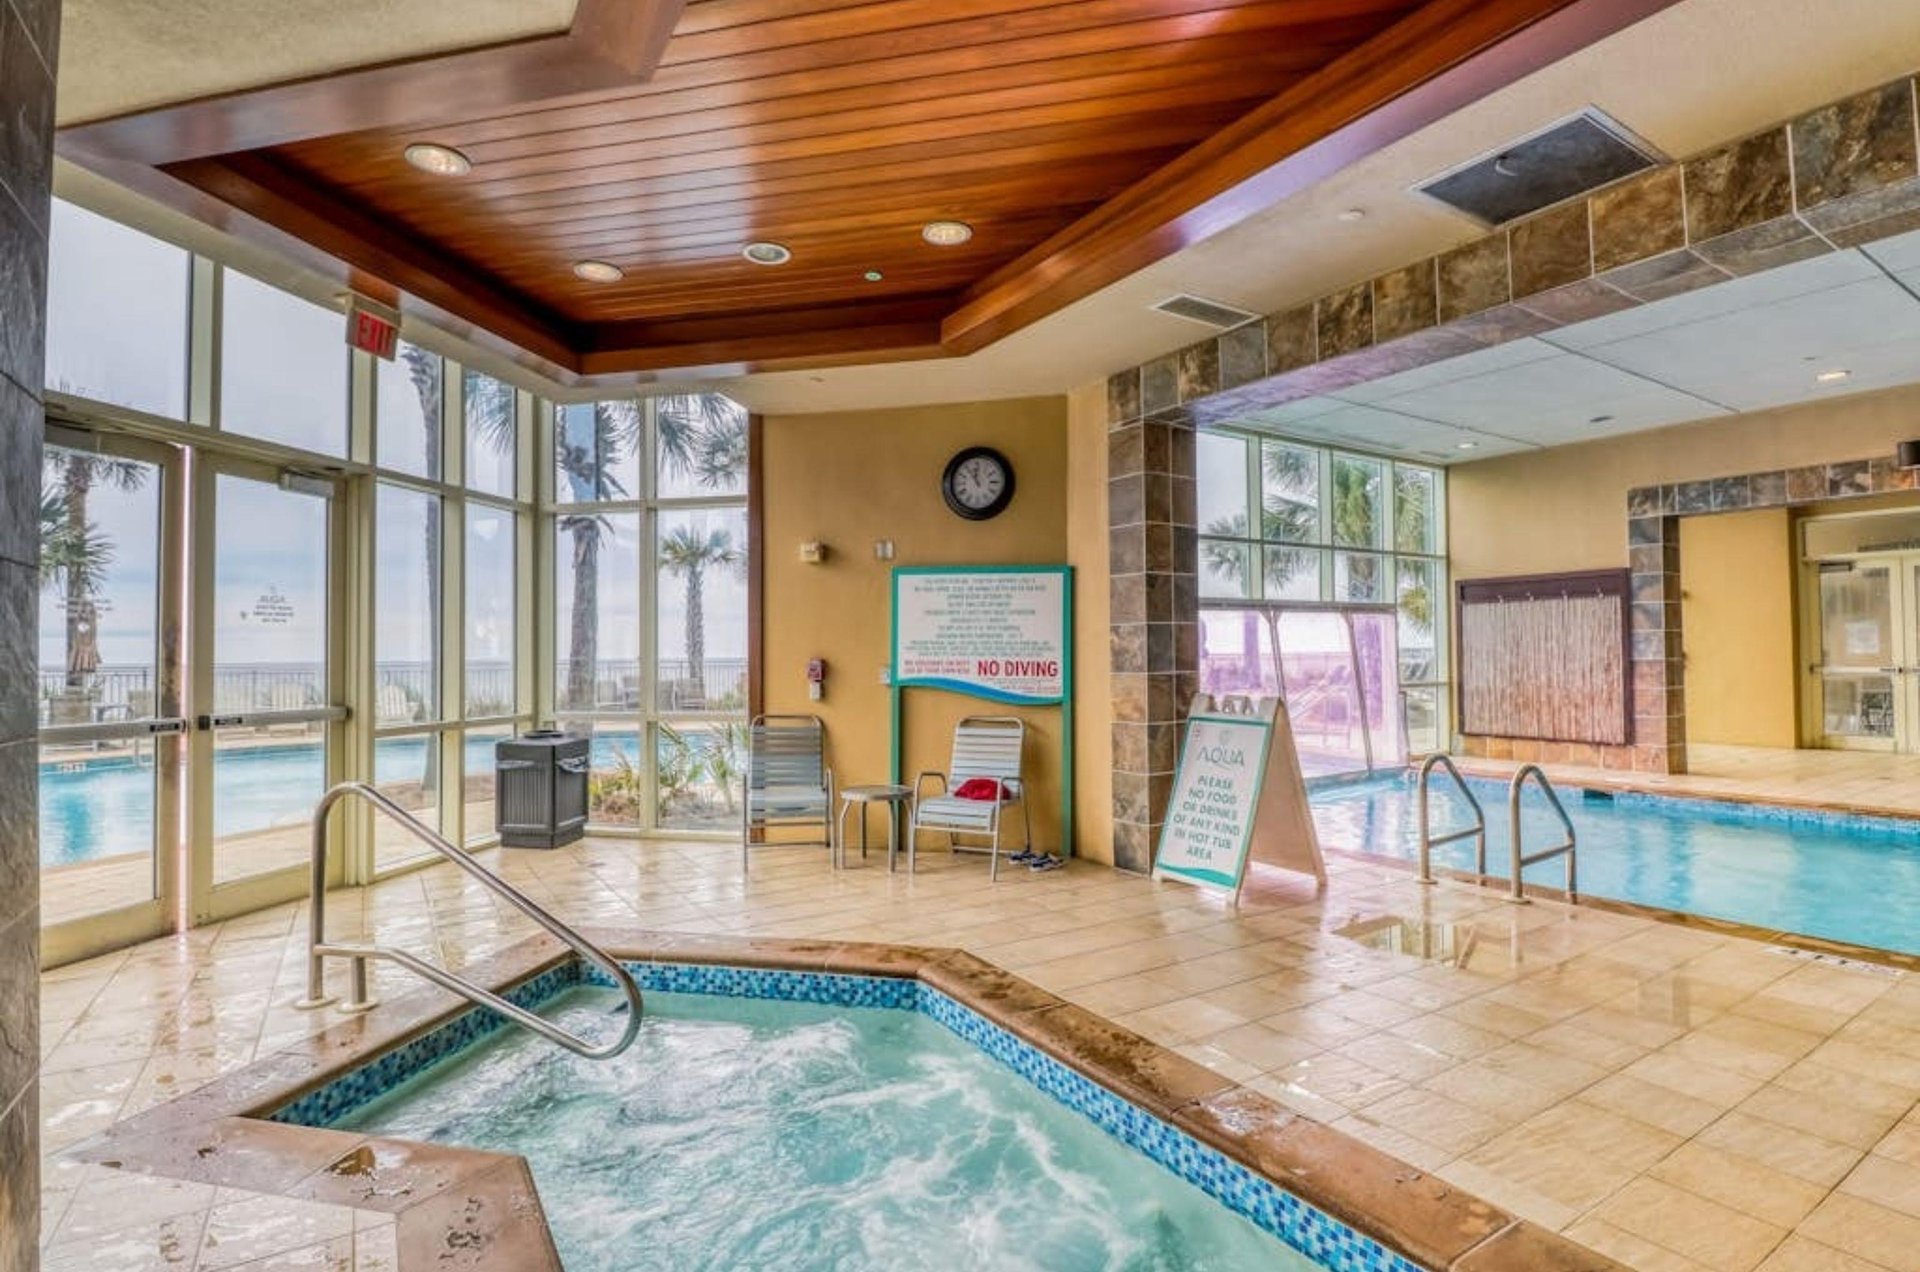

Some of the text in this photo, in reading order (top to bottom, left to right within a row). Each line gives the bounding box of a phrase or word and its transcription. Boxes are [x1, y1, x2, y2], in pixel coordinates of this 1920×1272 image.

[977, 660, 1058, 677] NO DIVING
[1197, 745, 1245, 767] AQUA
[1198, 775, 1233, 789] PLEASE
[1188, 787, 1237, 805] NO FOOD
[1183, 800, 1238, 821] OR DRINKS
[1173, 814, 1240, 837] OF ANY KIND
[1174, 826, 1232, 850] IN HOT TUB
[1186, 846, 1212, 860] AREA
